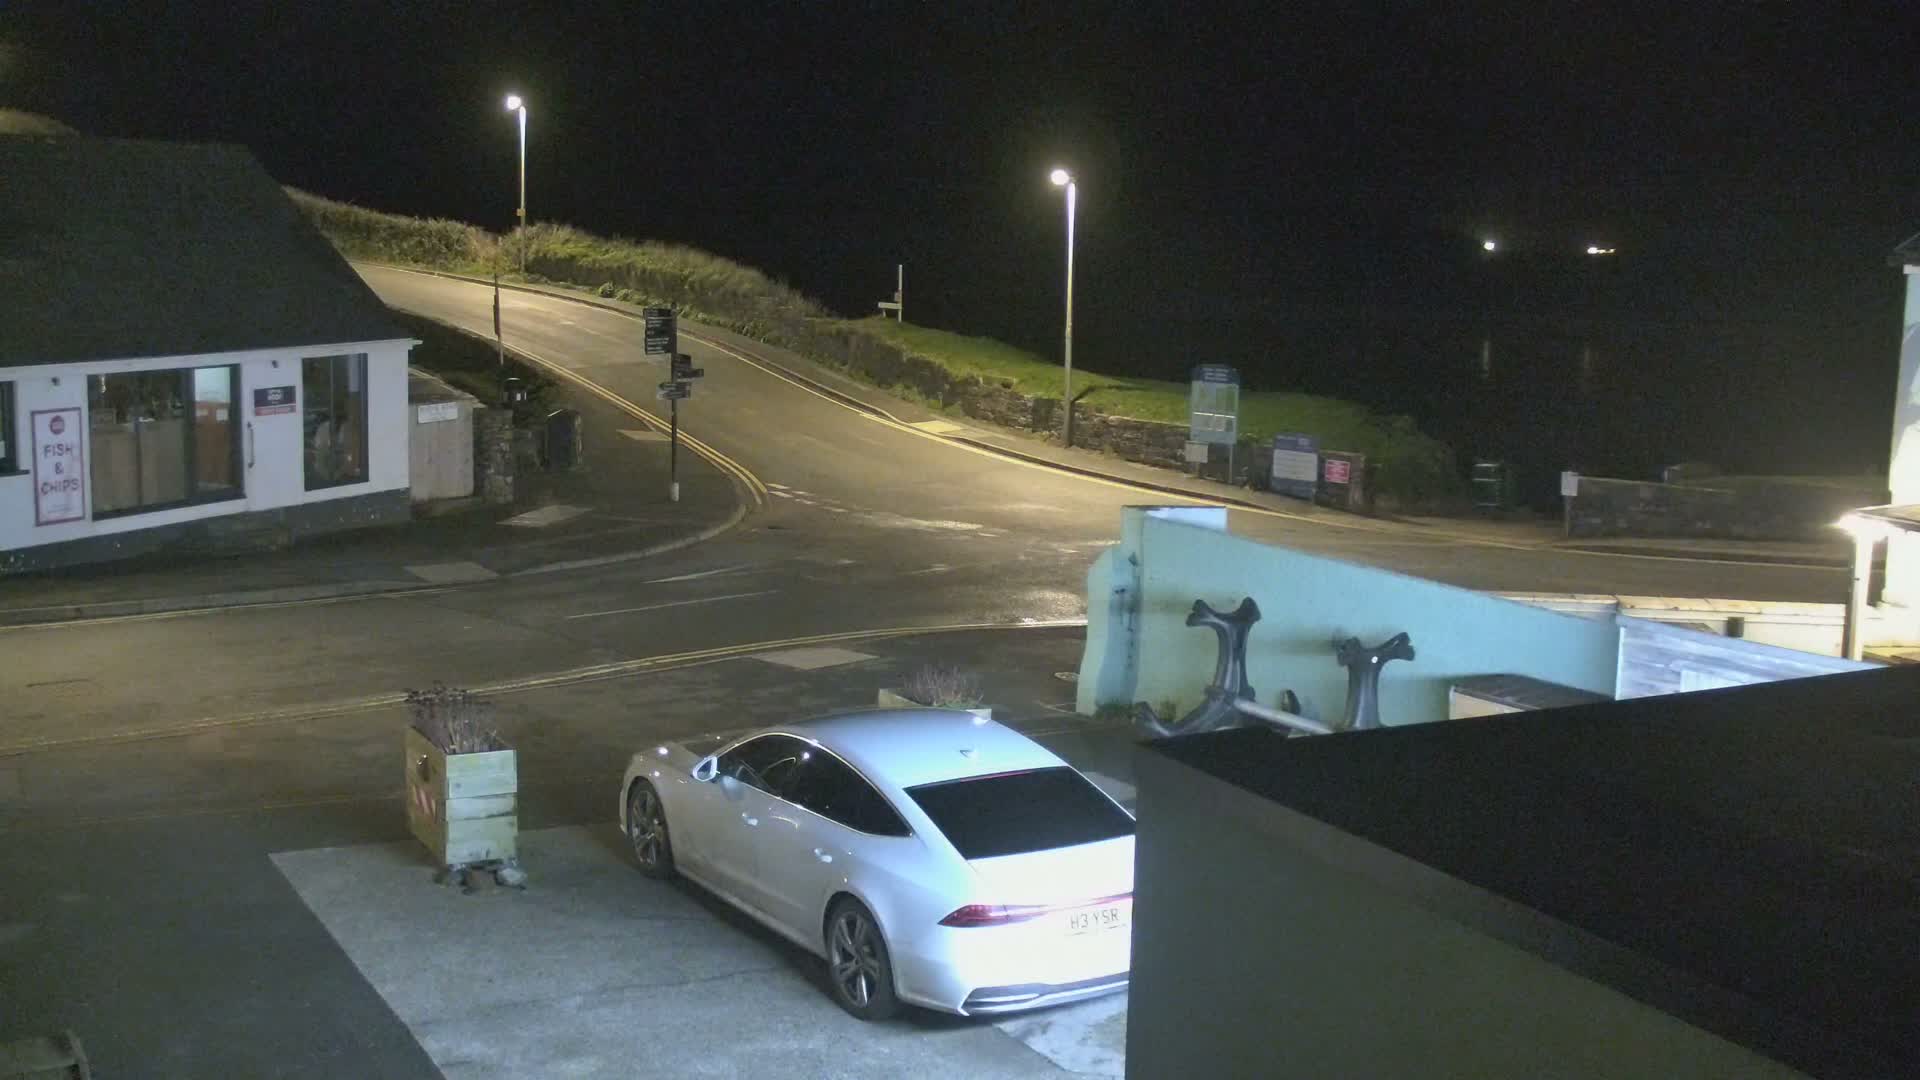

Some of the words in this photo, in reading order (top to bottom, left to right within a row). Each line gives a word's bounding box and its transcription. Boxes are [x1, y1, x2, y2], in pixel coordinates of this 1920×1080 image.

[44, 443, 72, 458] FISH
[55, 462, 63, 475] &
[41, 479, 79, 495] CHIPS
[1070, 911, 1089, 930] H3
[1093, 908, 1119, 925] YSR
